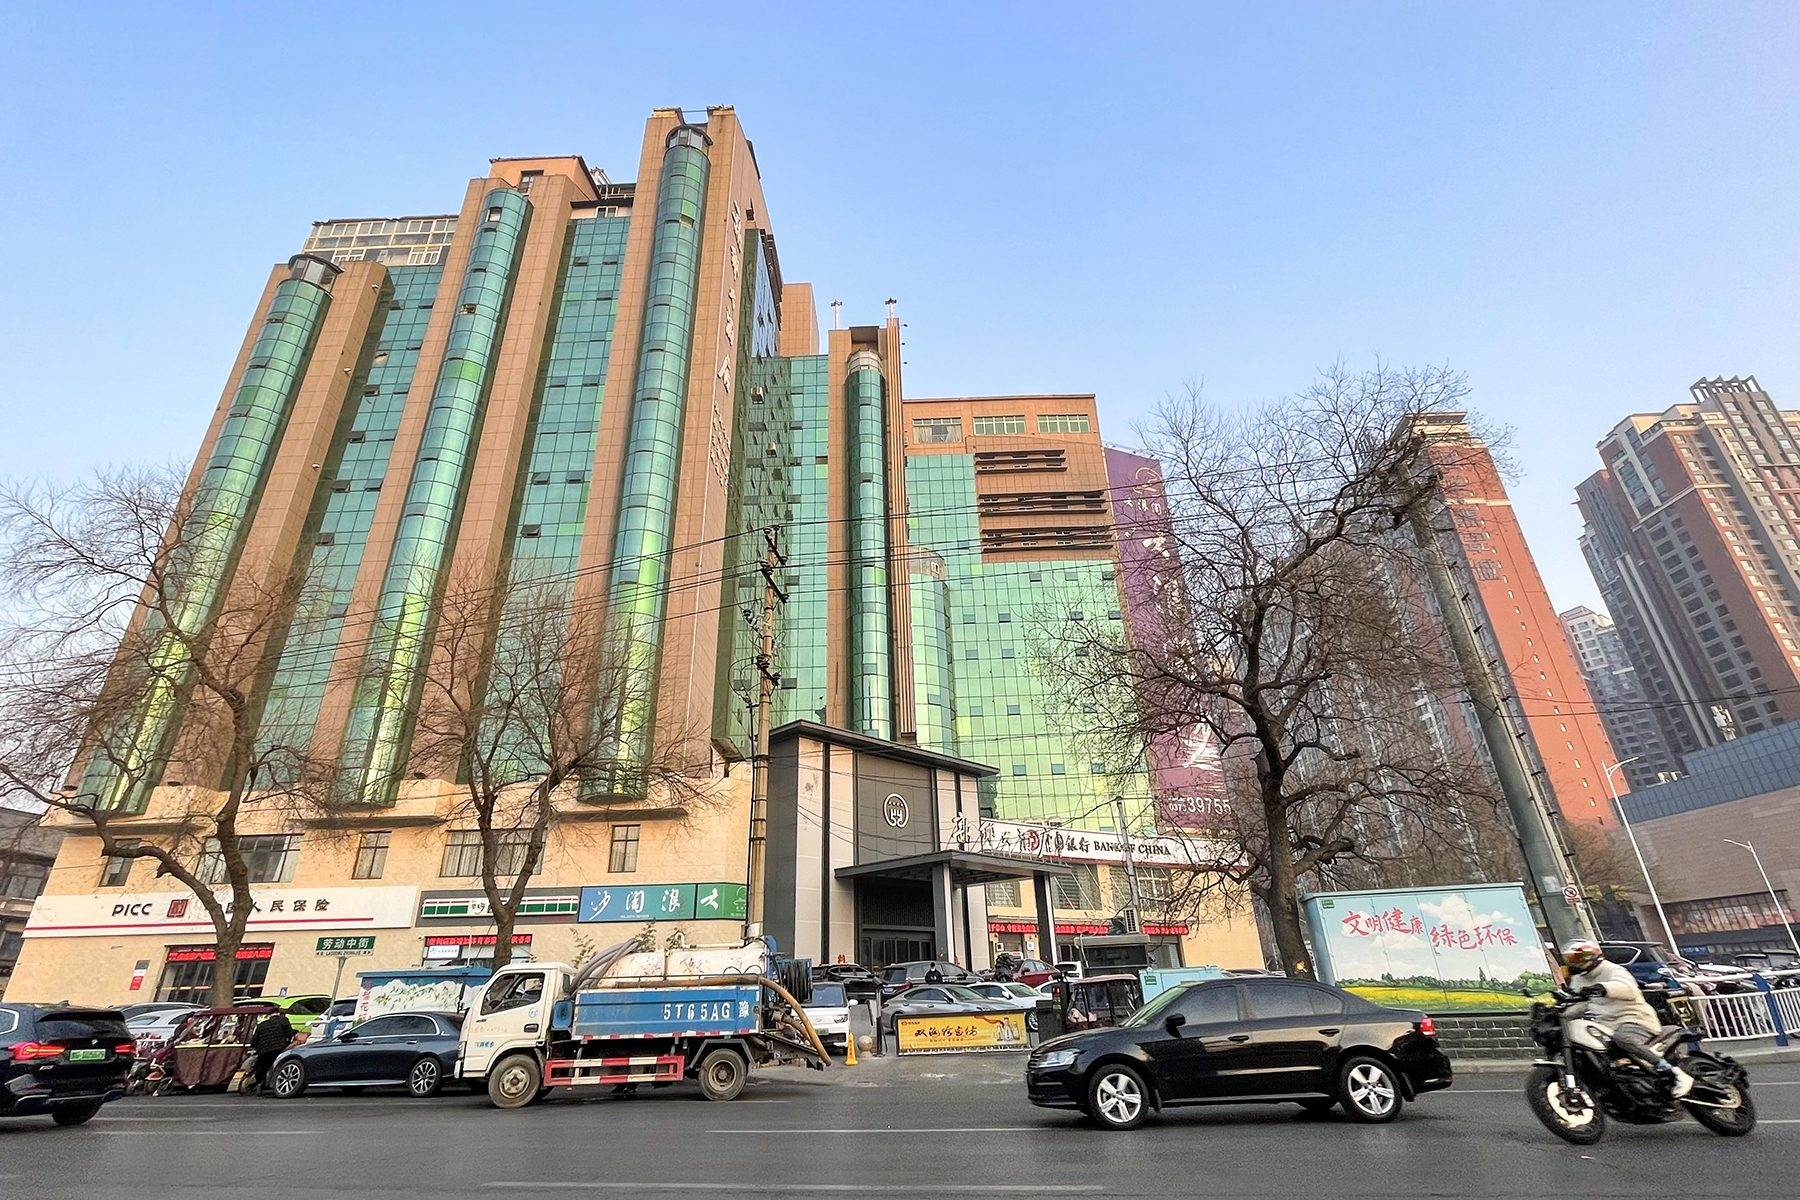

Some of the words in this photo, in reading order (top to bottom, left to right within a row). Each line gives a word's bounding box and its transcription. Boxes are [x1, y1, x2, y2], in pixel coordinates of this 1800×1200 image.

[1138, 844, 1171, 855] CHINA
[112, 903, 153, 916] PICC
[1342, 906, 1424, 936] 文明健康
[1430, 924, 1518, 951] 绿色环保
[322, 938, 369, 949] 劳动中街
